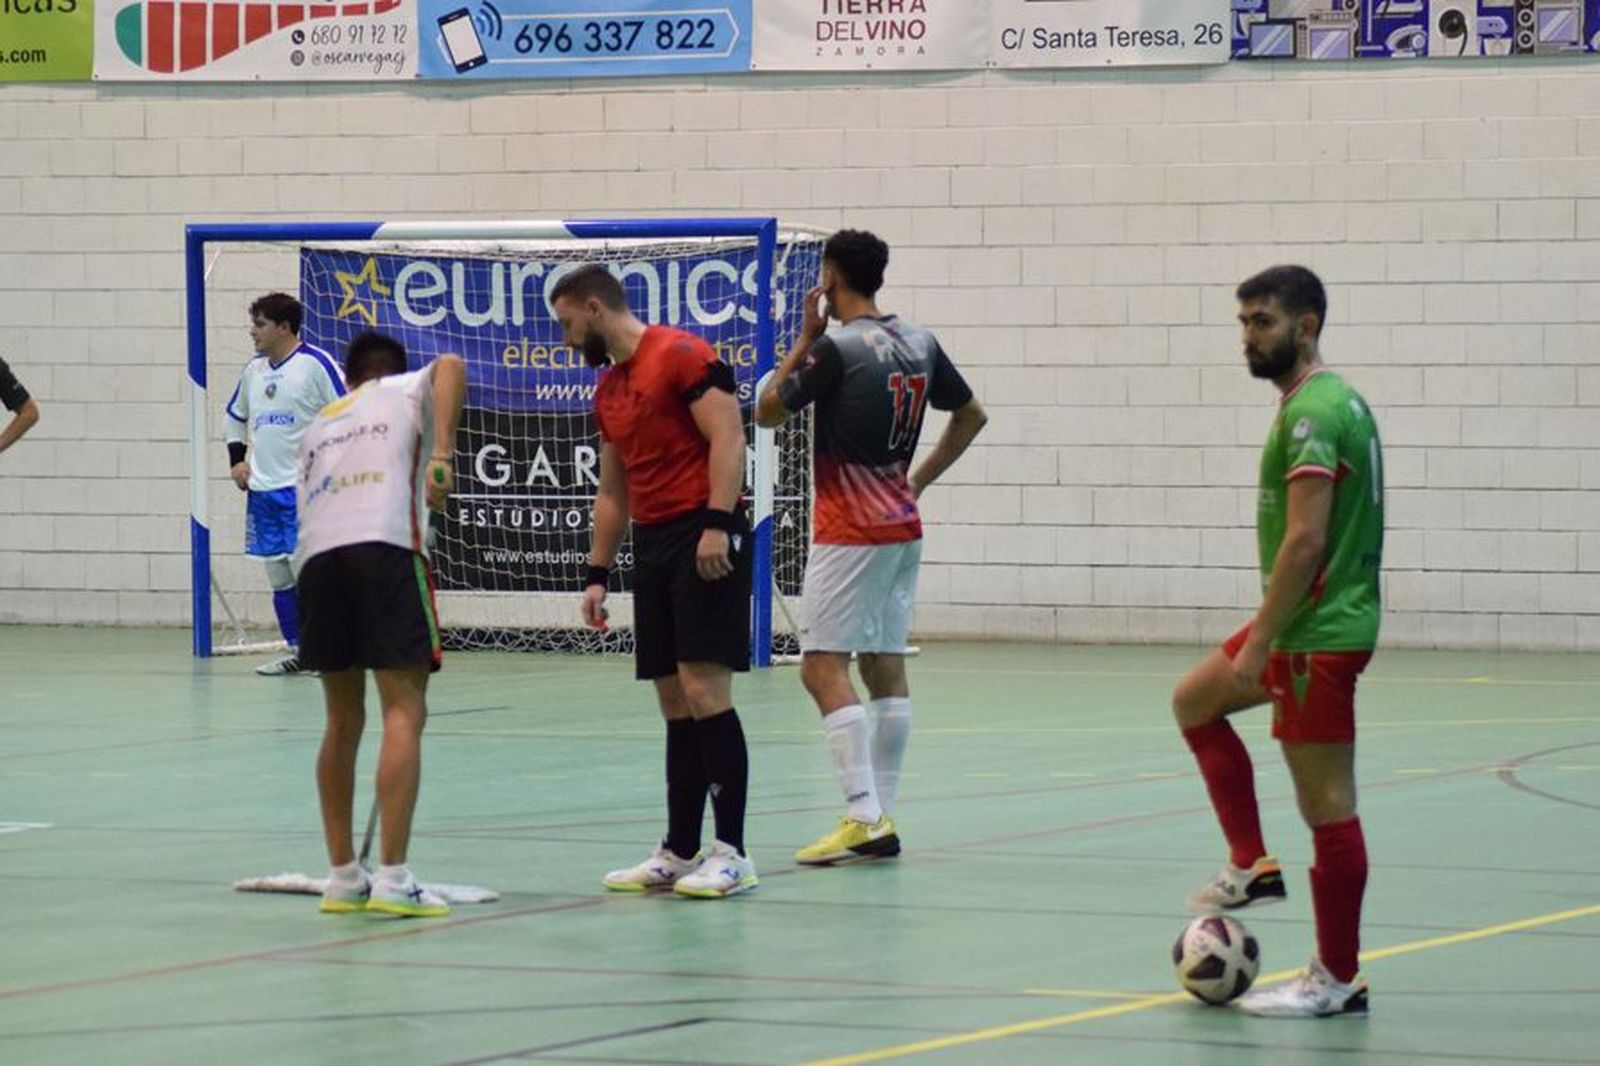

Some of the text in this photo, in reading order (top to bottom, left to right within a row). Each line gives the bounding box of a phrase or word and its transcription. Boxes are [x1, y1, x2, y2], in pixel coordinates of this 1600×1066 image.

[311, 24, 341, 45] 680
[348, 24, 364, 44] 91
[513, 18, 715, 54] 696 337 822
[1000, 23, 1223, 51] C/ Santa Teresa, 26
[816, 45, 926, 57] ZAMORA
